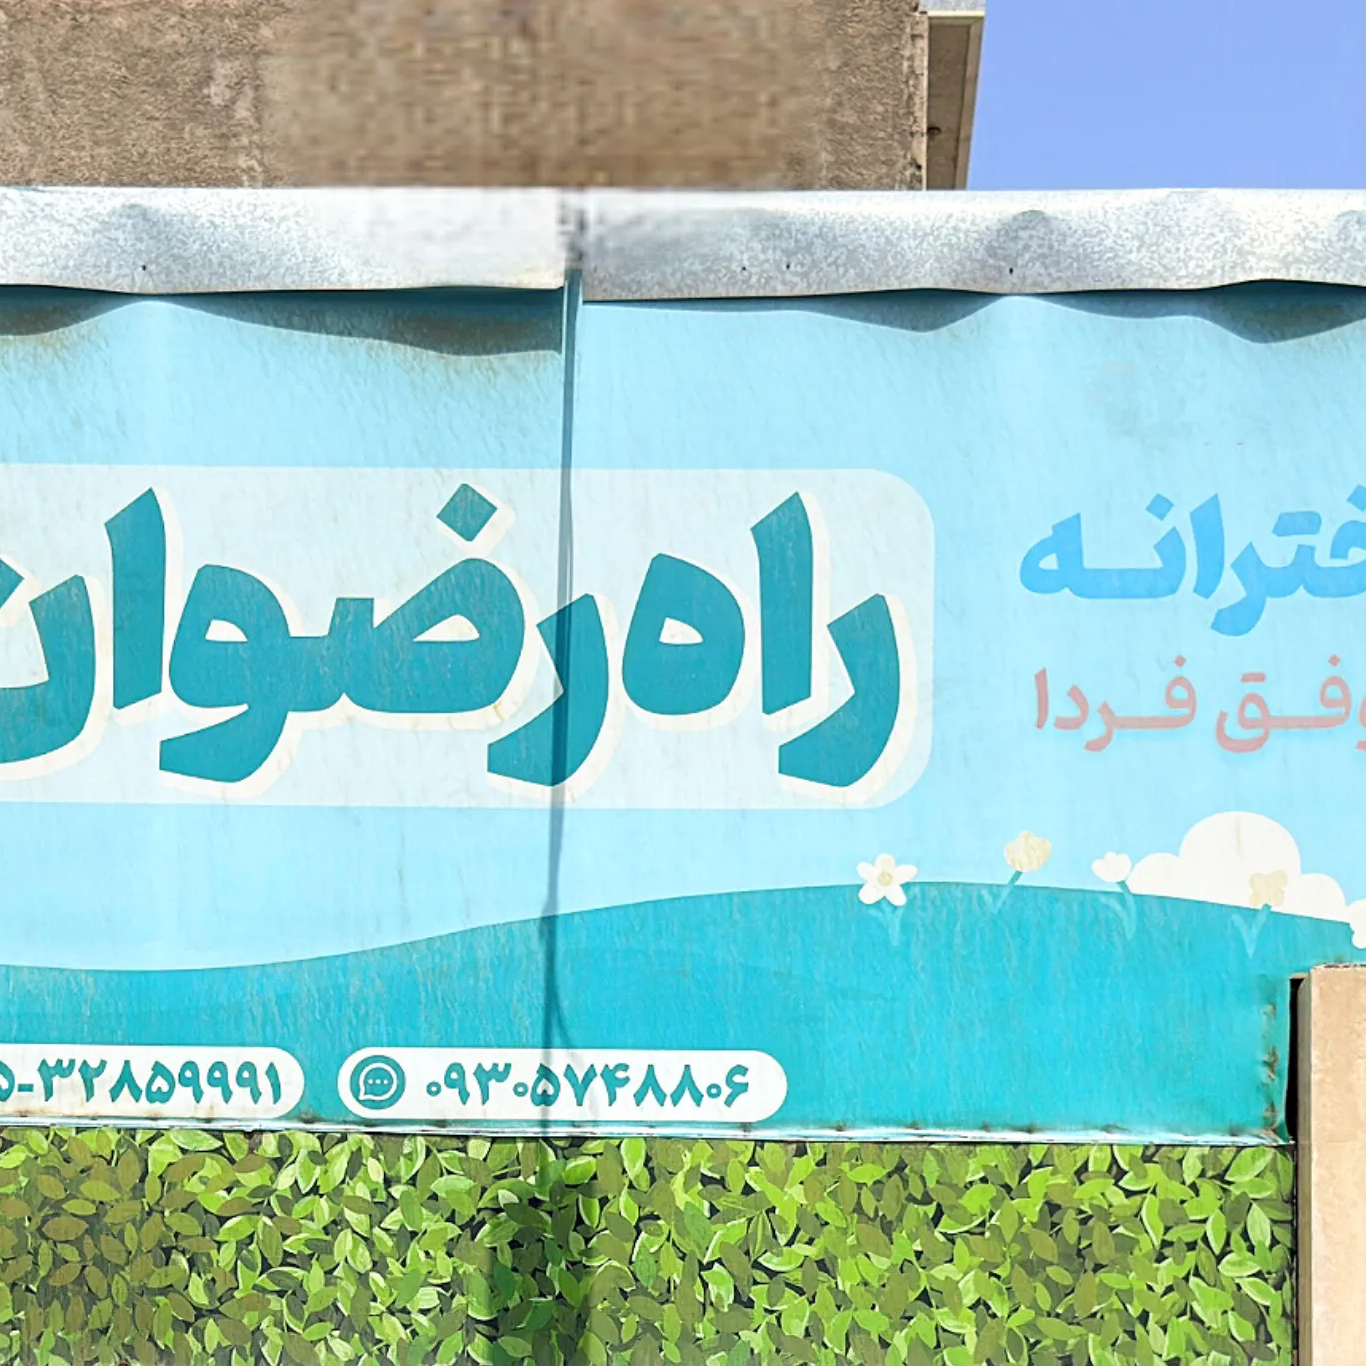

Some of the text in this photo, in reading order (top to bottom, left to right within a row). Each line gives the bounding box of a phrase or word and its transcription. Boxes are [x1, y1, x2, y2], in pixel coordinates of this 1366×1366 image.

[621, 491, 900, 787] راه
[1033, 655, 1196, 753] فردا
[426, 1062, 749, 1108] ۰۹۳۰۵۷۴۸۸۰۶
